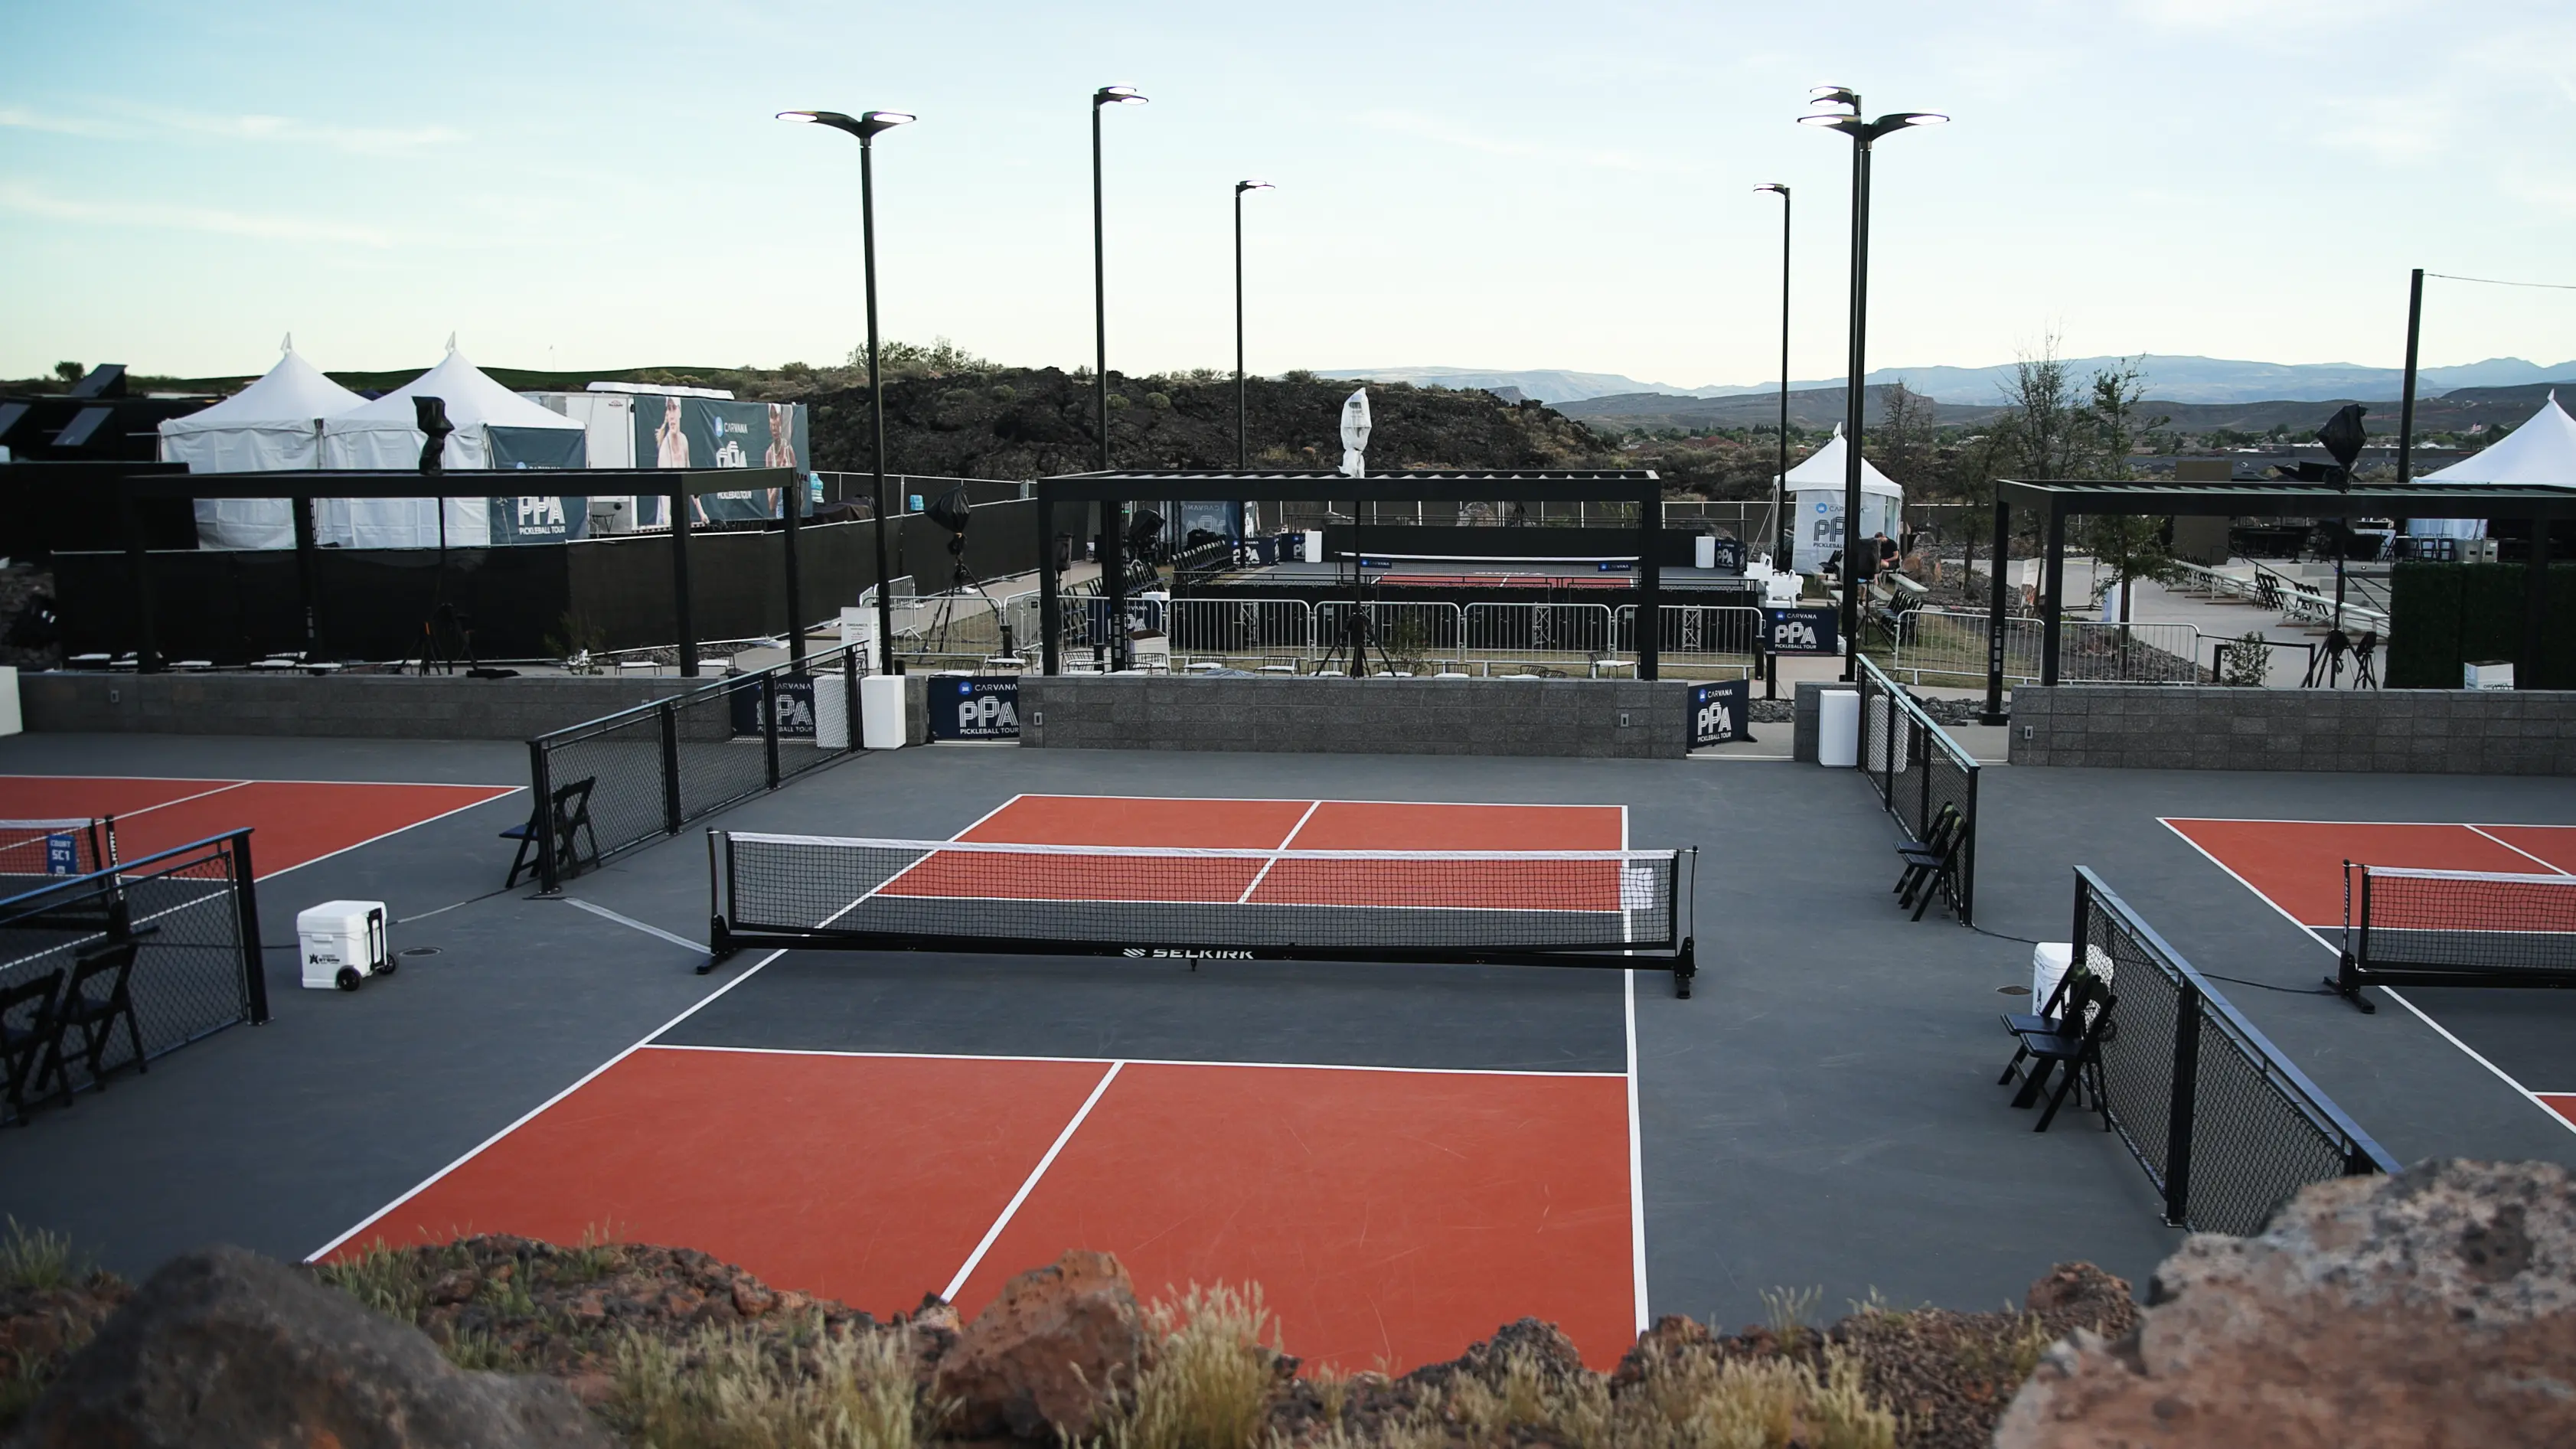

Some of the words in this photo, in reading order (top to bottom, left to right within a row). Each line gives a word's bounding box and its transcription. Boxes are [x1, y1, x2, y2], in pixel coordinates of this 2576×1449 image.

[724, 423, 748, 434] CARVANA
[519, 527, 550, 535] PICKLEBALL
[1814, 516, 1845, 542] PP
[1717, 548, 1734, 564] PPA
[1774, 622, 1817, 644] PPA
[1707, 689, 1732, 698] CARVANA
[958, 695, 1020, 728] PPA
[1697, 701, 1732, 736] PPA
[1697, 734, 1720, 742] PICKLEBALL
[52, 850, 70, 861] SC1
[1152, 948, 1255, 960] SELKIRK
